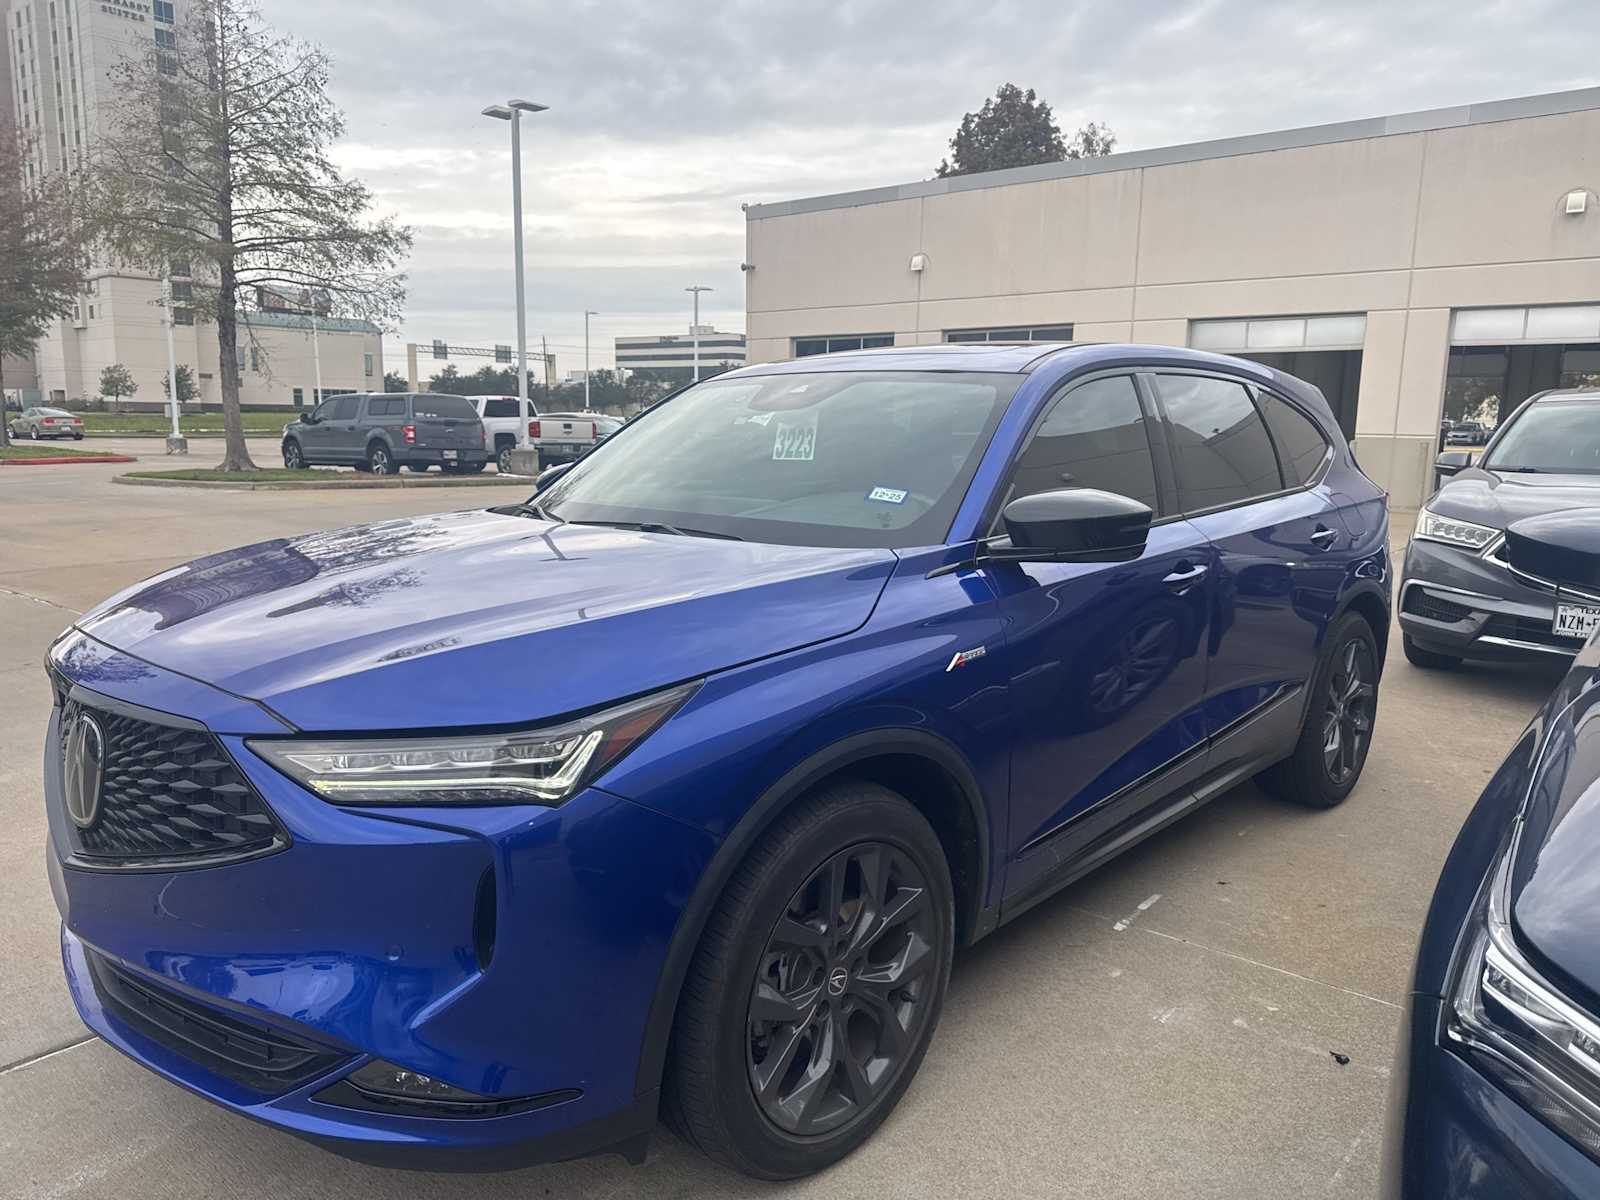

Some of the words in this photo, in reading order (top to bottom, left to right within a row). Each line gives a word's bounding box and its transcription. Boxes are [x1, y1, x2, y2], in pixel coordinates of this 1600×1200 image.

[101, 4, 145, 21] SUITES
[775, 429, 814, 458] 3223
[874, 491, 902, 501] 12-25
